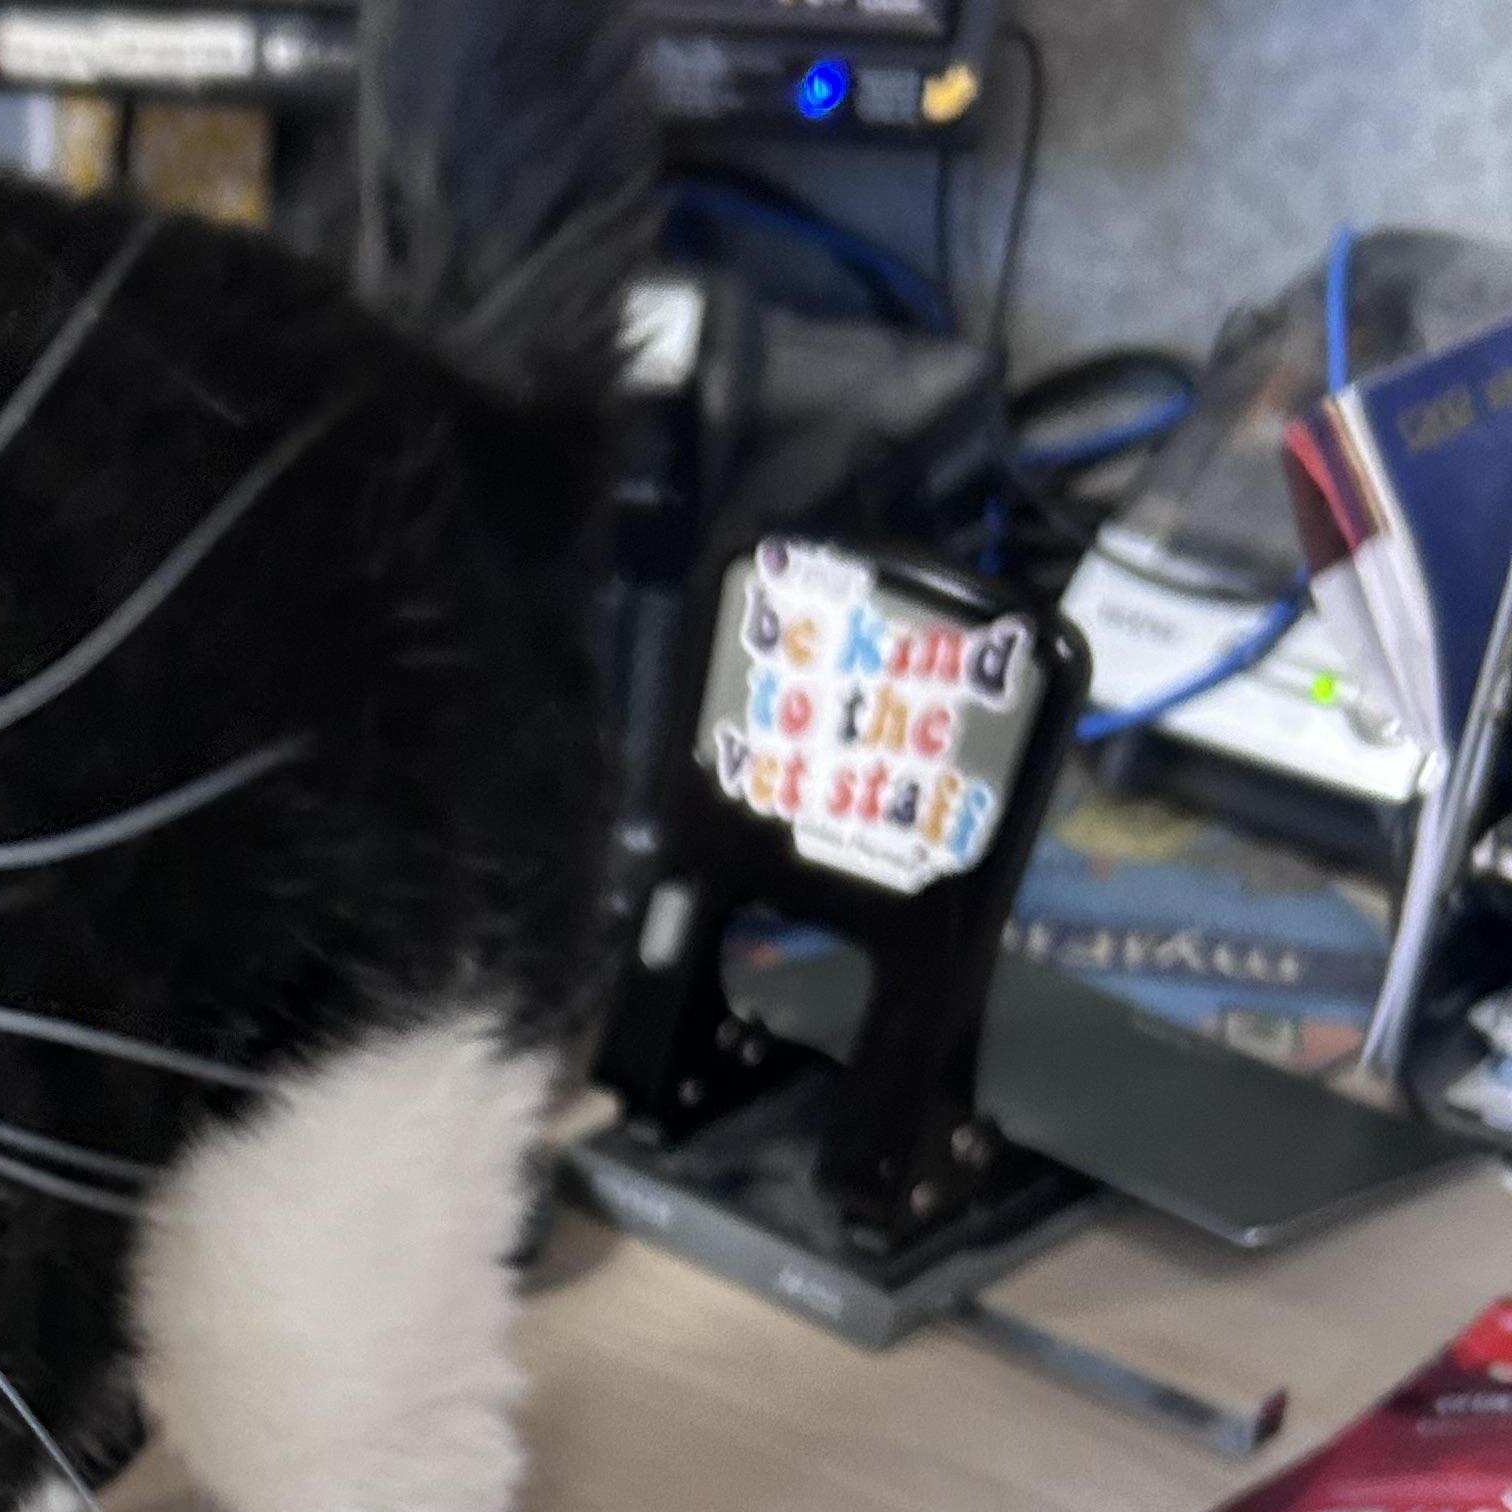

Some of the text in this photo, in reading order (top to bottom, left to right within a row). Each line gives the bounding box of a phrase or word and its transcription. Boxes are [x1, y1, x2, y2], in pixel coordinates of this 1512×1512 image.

[747, 588, 817, 664] be
[840, 606, 1021, 696] kind
[751, 670, 952, 758] to the
[720, 732, 806, 810] vet
[826, 762, 988, 861] staff
